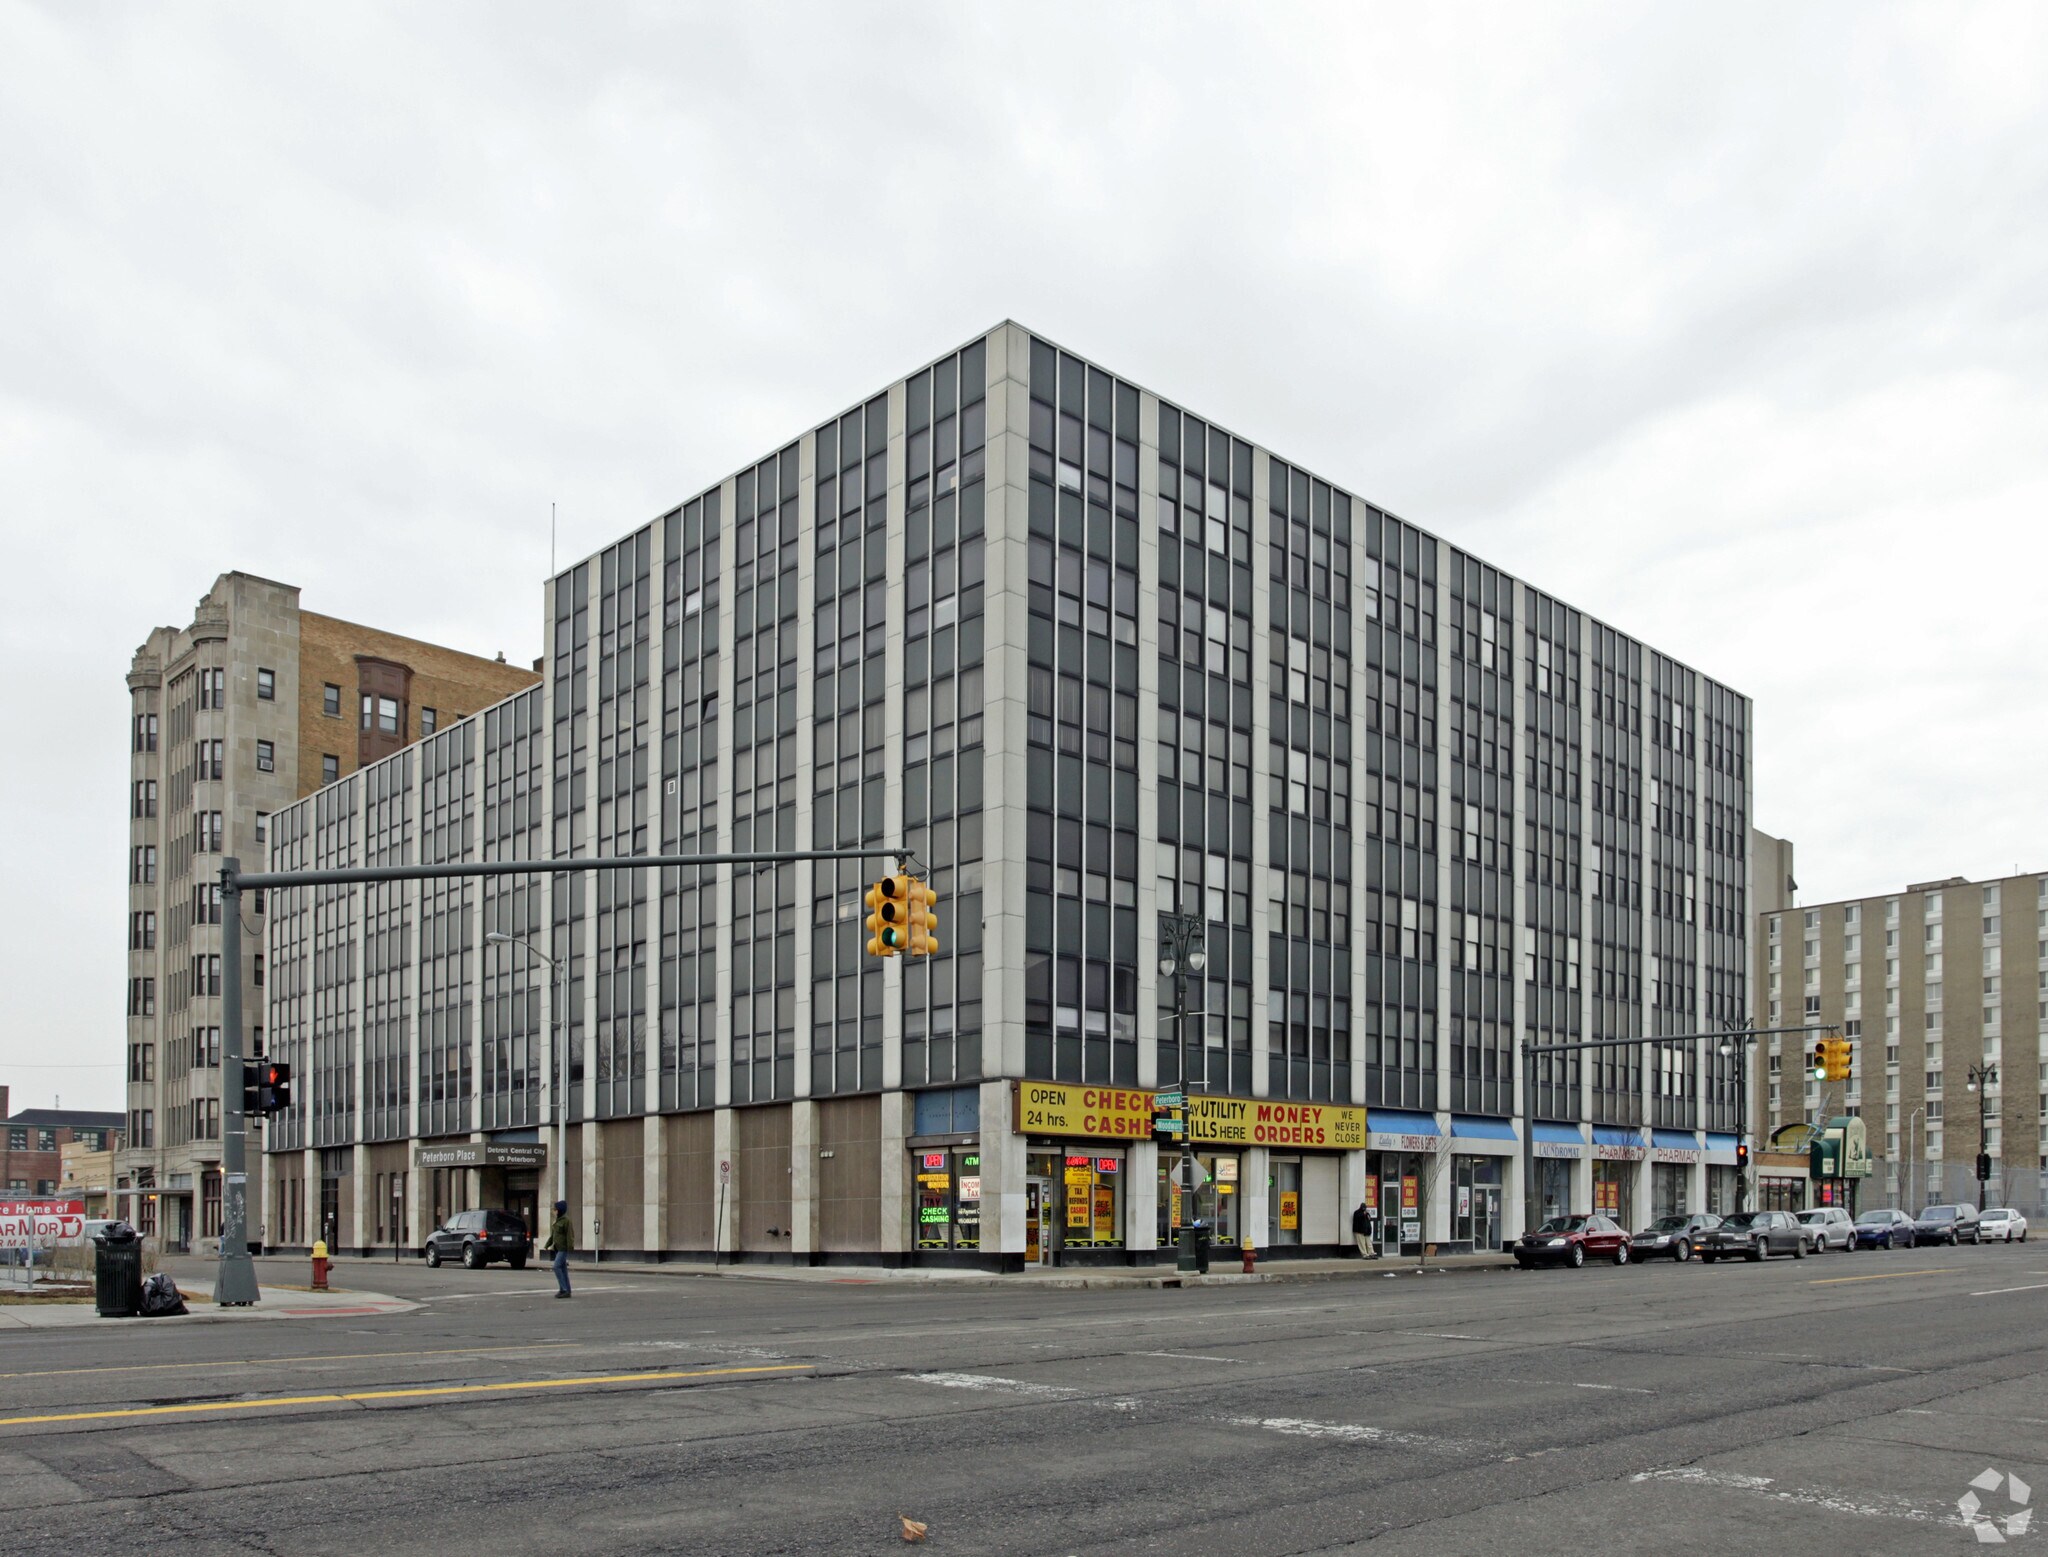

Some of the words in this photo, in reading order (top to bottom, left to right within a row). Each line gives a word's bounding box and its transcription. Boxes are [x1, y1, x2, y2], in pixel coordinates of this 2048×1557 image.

[1030, 1089, 1066, 1105] OPEN
[1155, 1094, 1181, 1105] Peterboro
[1189, 1103, 1201, 1117] AY
[1201, 1101, 1246, 1120] UTILITY
[1257, 1105, 1323, 1124] MONEY
[1341, 1110, 1353, 1120] WE
[1027, 1110, 1043, 1125] 24
[1047, 1112, 1069, 1127] hrs.
[1083, 1115, 1152, 1136] CASHE
[1157, 1120, 1183, 1131] Woodward
[1191, 1121, 1217, 1139] ILLS
[1220, 1126, 1246, 1140] HERE
[1334, 1121, 1360, 1133] NEVER
[1254, 1125, 1326, 1144] ORDERS
[1334, 1132, 1360, 1144] CLOSE
[422, 1151, 455, 1163] Peterboro
[456, 1150, 476, 1161] Place
[510, 1147, 532, 1155] Central
[533, 1148, 546, 1156] City
[1538, 1145, 1580, 1158] LAUNDROMAT
[1657, 1148, 1702, 1163] PHARMACY
[925, 1154, 943, 1168] OPEN
[964, 1157, 979, 1166] ATM
[1099, 1158, 1117, 1171] OPEN
[960, 1180, 980, 1189] INCOM
[967, 1189, 979, 1198] TAX
[16, 1203, 51, 1214] Home
[56, 1203, 69, 1213] of
[922, 1207, 948, 1215] CHECK
[921, 1215, 950, 1223] CASHING
